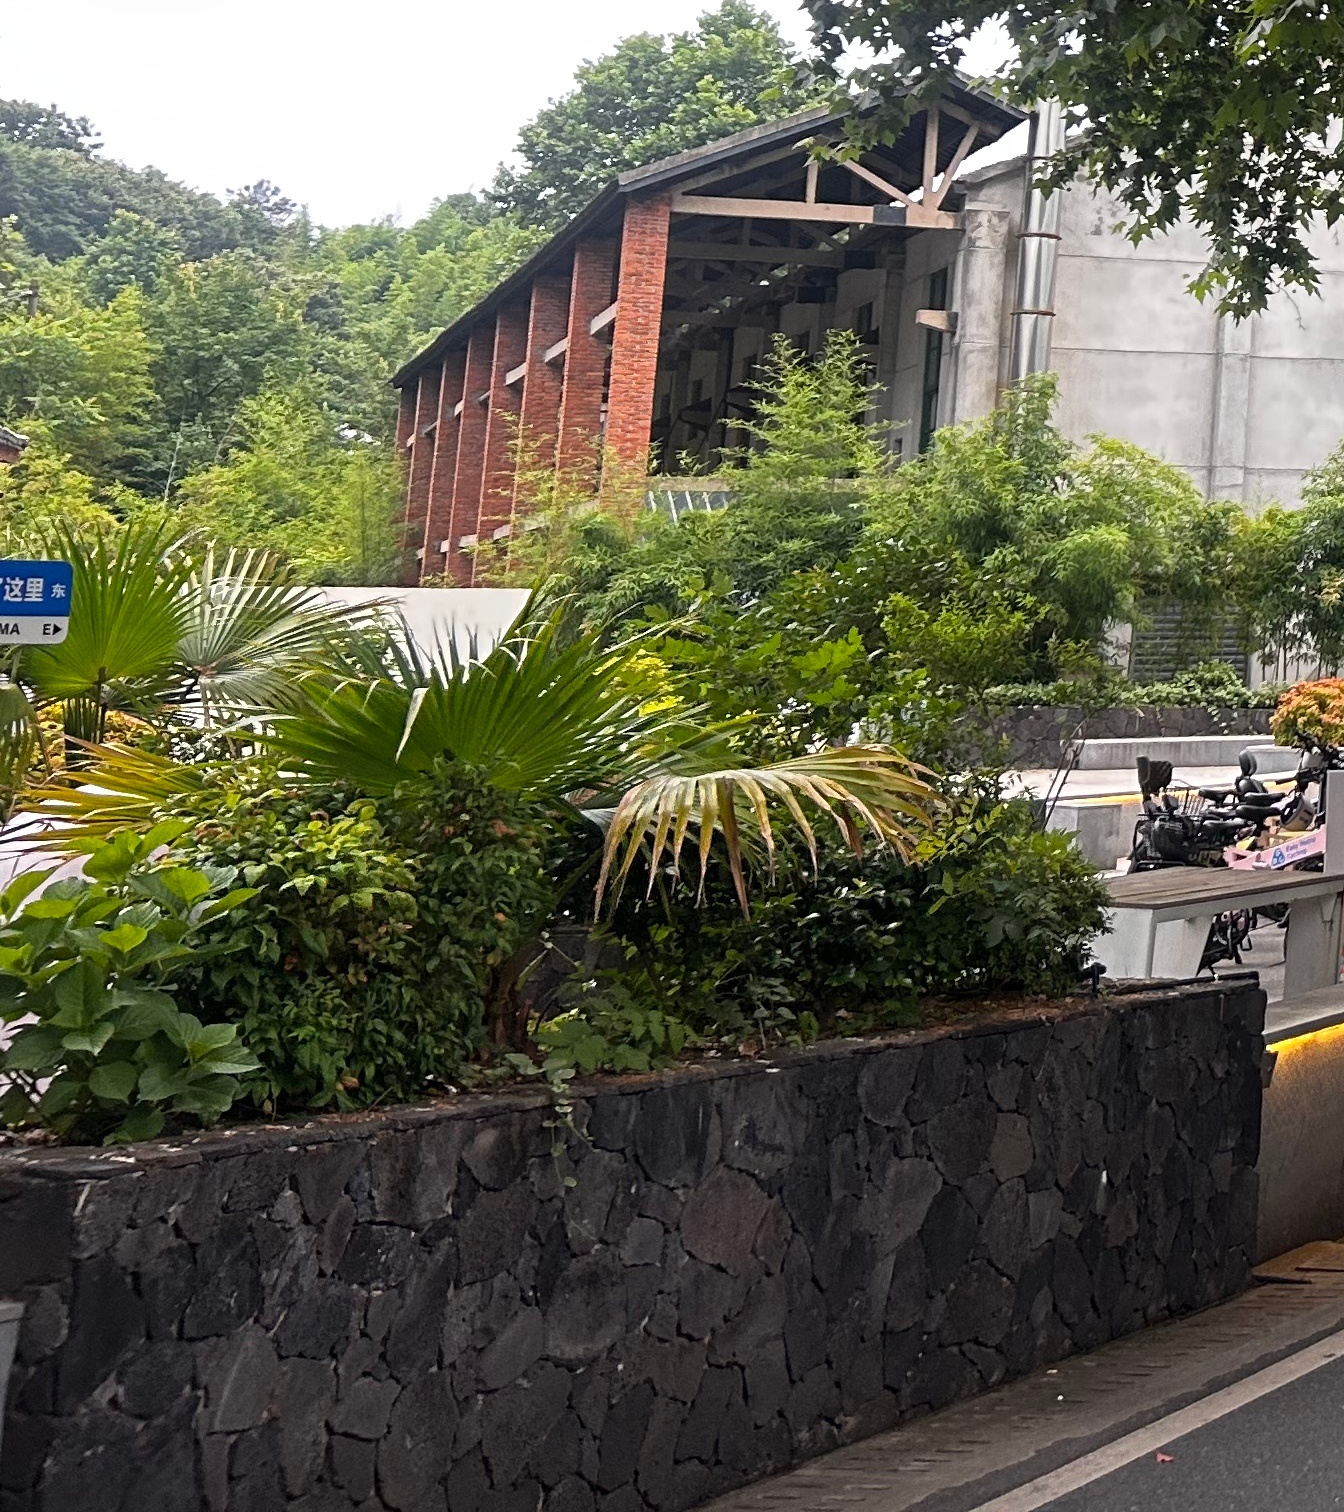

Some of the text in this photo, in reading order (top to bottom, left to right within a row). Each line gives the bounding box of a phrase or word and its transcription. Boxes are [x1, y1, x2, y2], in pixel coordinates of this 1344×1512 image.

[0, 576, 66, 602] 这里 东
[42, 623, 51, 636] E
